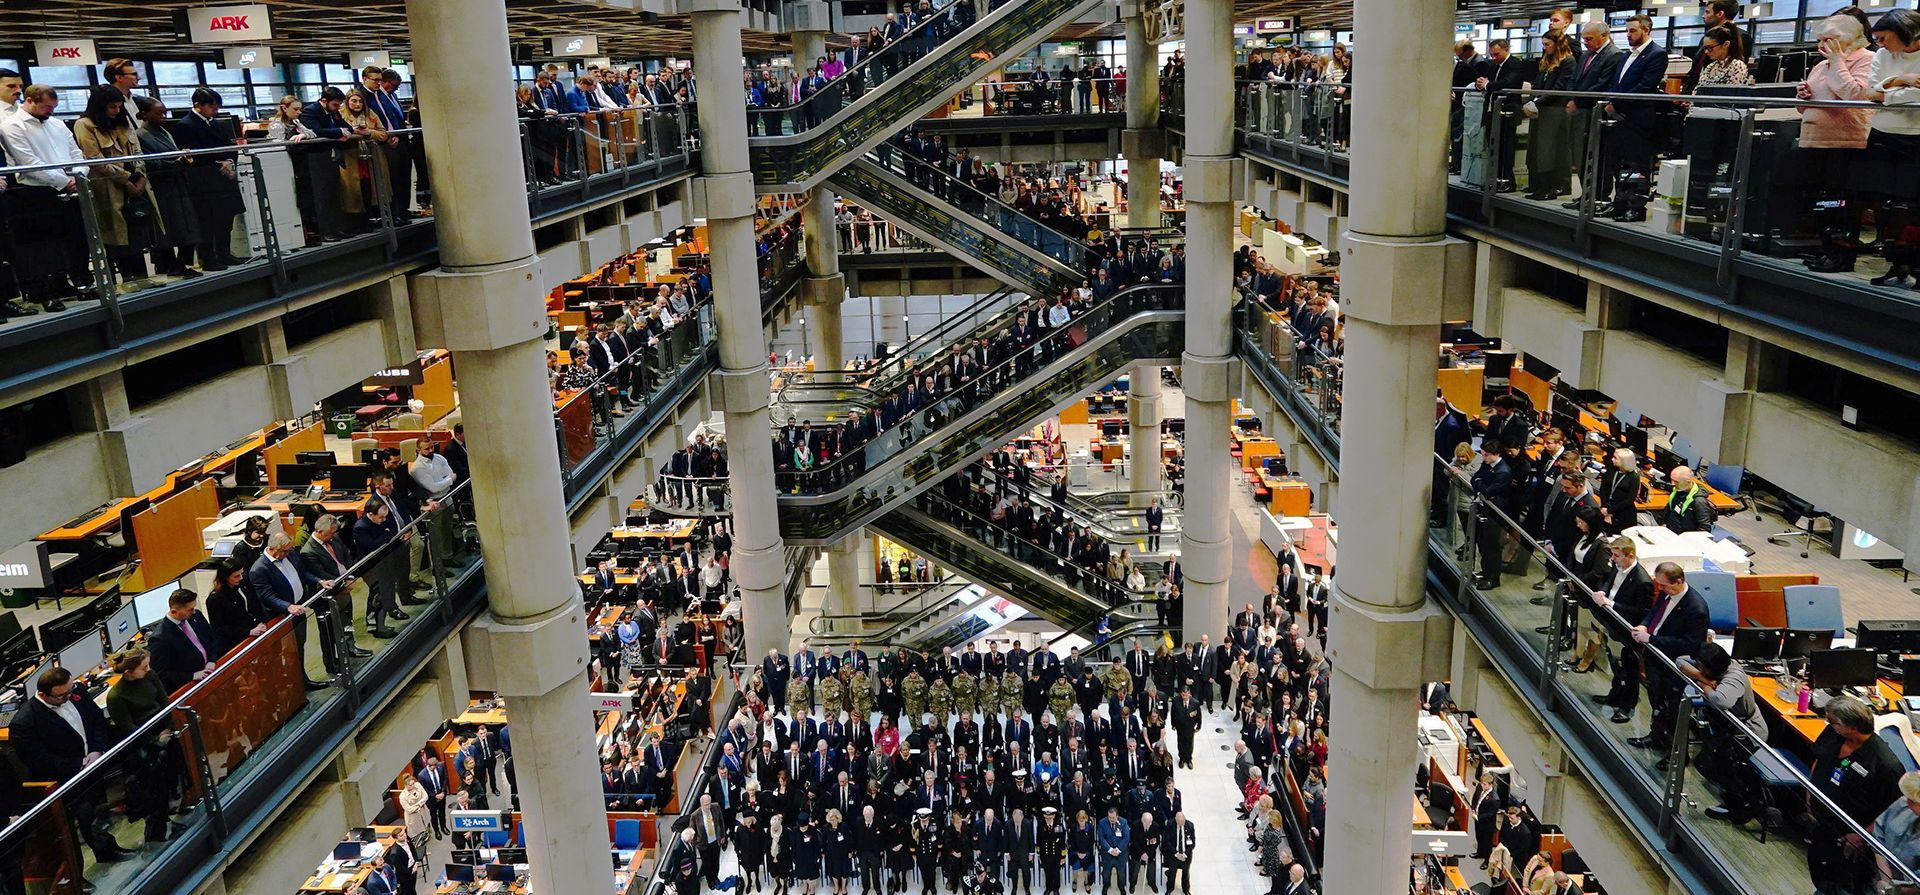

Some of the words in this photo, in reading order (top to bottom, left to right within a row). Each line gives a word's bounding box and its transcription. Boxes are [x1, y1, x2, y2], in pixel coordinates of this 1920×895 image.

[209, 15, 250, 31] ARK
[51, 47, 81, 58] ARK
[601, 699, 622, 707] ARK
[472, 818, 490, 826] Arch
